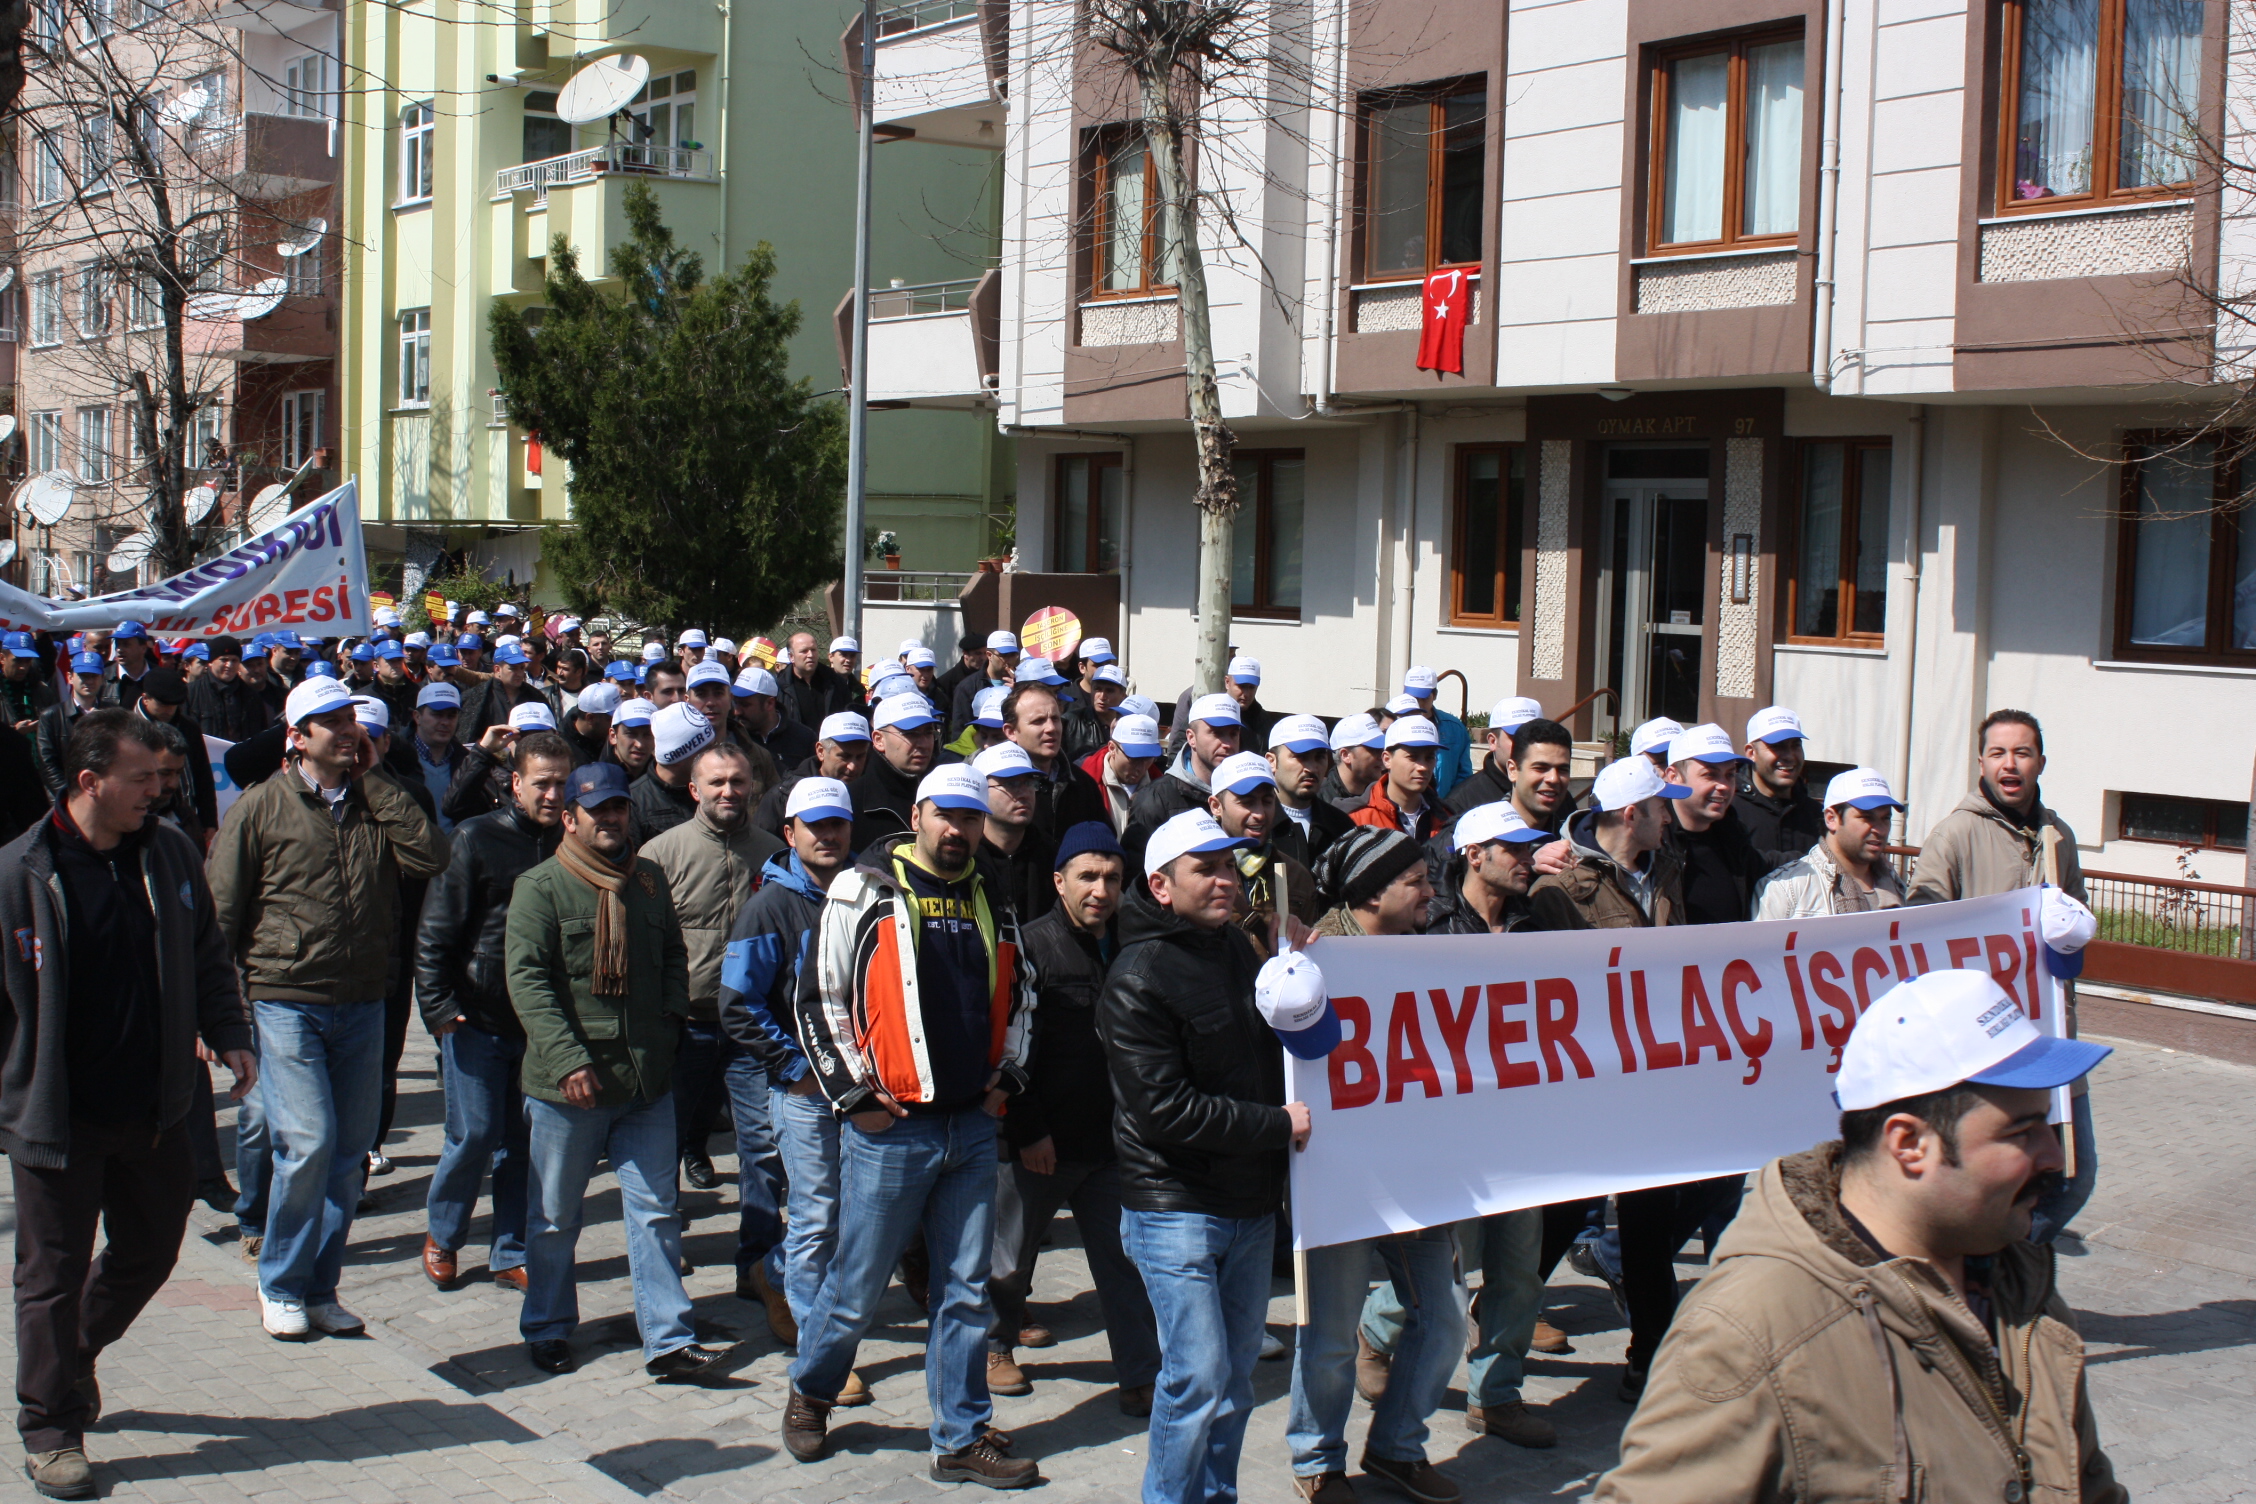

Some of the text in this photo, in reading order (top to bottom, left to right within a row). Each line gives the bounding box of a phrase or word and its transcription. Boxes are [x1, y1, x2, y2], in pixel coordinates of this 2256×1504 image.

[1598, 416, 1697, 434] OYMAK APT
[1735, 418, 1755, 435] 97
[1042, 637, 1061, 651] SON!
[664, 733, 705, 762] SARIYER
[1327, 908, 2041, 1111] BAYER İLAÇ İŞİRİ
